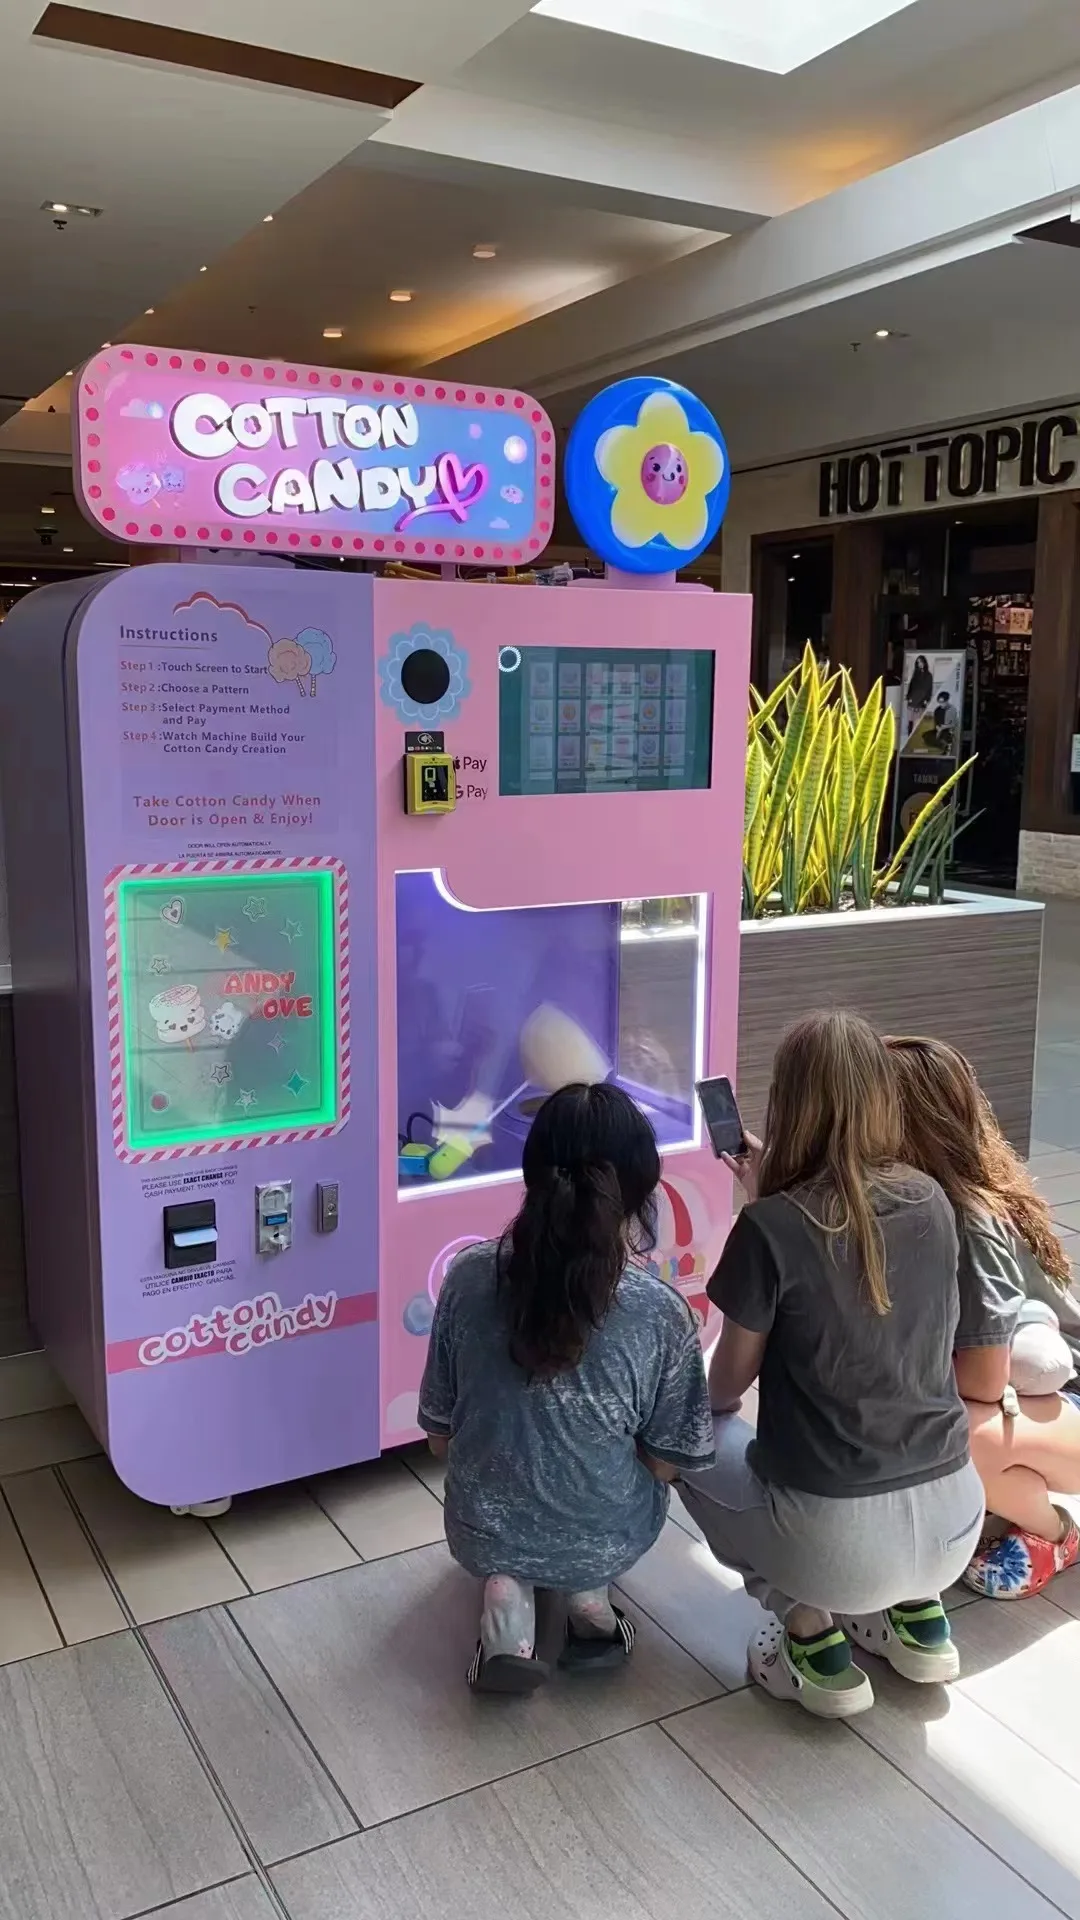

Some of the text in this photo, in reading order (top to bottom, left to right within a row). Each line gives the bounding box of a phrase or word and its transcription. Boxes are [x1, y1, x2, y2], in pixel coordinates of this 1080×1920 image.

[170, 392, 418, 460] COTTON
[819, 415, 1078, 517] HOT TOPIC
[215, 457, 437, 517] CANDY
[120, 625, 218, 642] Instructions
[121, 660, 146, 673] Step
[195, 663, 229, 673] Screen
[231, 664, 241, 674] to
[244, 664, 268, 675] Start
[121, 682, 147, 694] Step
[149, 683, 156, 692] 2
[203, 685, 209, 693] a
[212, 684, 249, 695] Pattern
[122, 702, 148, 714] Step
[150, 703, 156, 712] 3
[199, 703, 246, 715] Payment
[250, 704, 290, 715] Method
[163, 715, 206, 727] and Pay
[123, 731, 148, 743] Step
[150, 732, 156, 741] 4
[202, 731, 247, 742] Machine
[251, 732, 277, 742] Build
[281, 732, 305, 742] Your
[163, 743, 286, 755] Cotton Candy Creation
[463, 756, 487, 772] Pay
[467, 784, 488, 799] Pay
[133, 794, 321, 809] Take Cotton Candy When
[148, 812, 313, 828] Door is Open & Enjoy!
[142, 1181, 167, 1191] PLEASE
[168, 1179, 181, 1187] USE
[183, 1175, 200, 1184] EXACT
[201, 1172, 223, 1182] CHANGE
[144, 1190, 163, 1198] CASH
[197, 1182, 219, 1190] THANK
[145, 1267, 233, 1290] UTILICE CAMBIO EXACTO PARA
[142, 1289, 161, 1298] PAGO
[140, 1293, 280, 1363] cotton
[227, 1292, 335, 1354] candy
